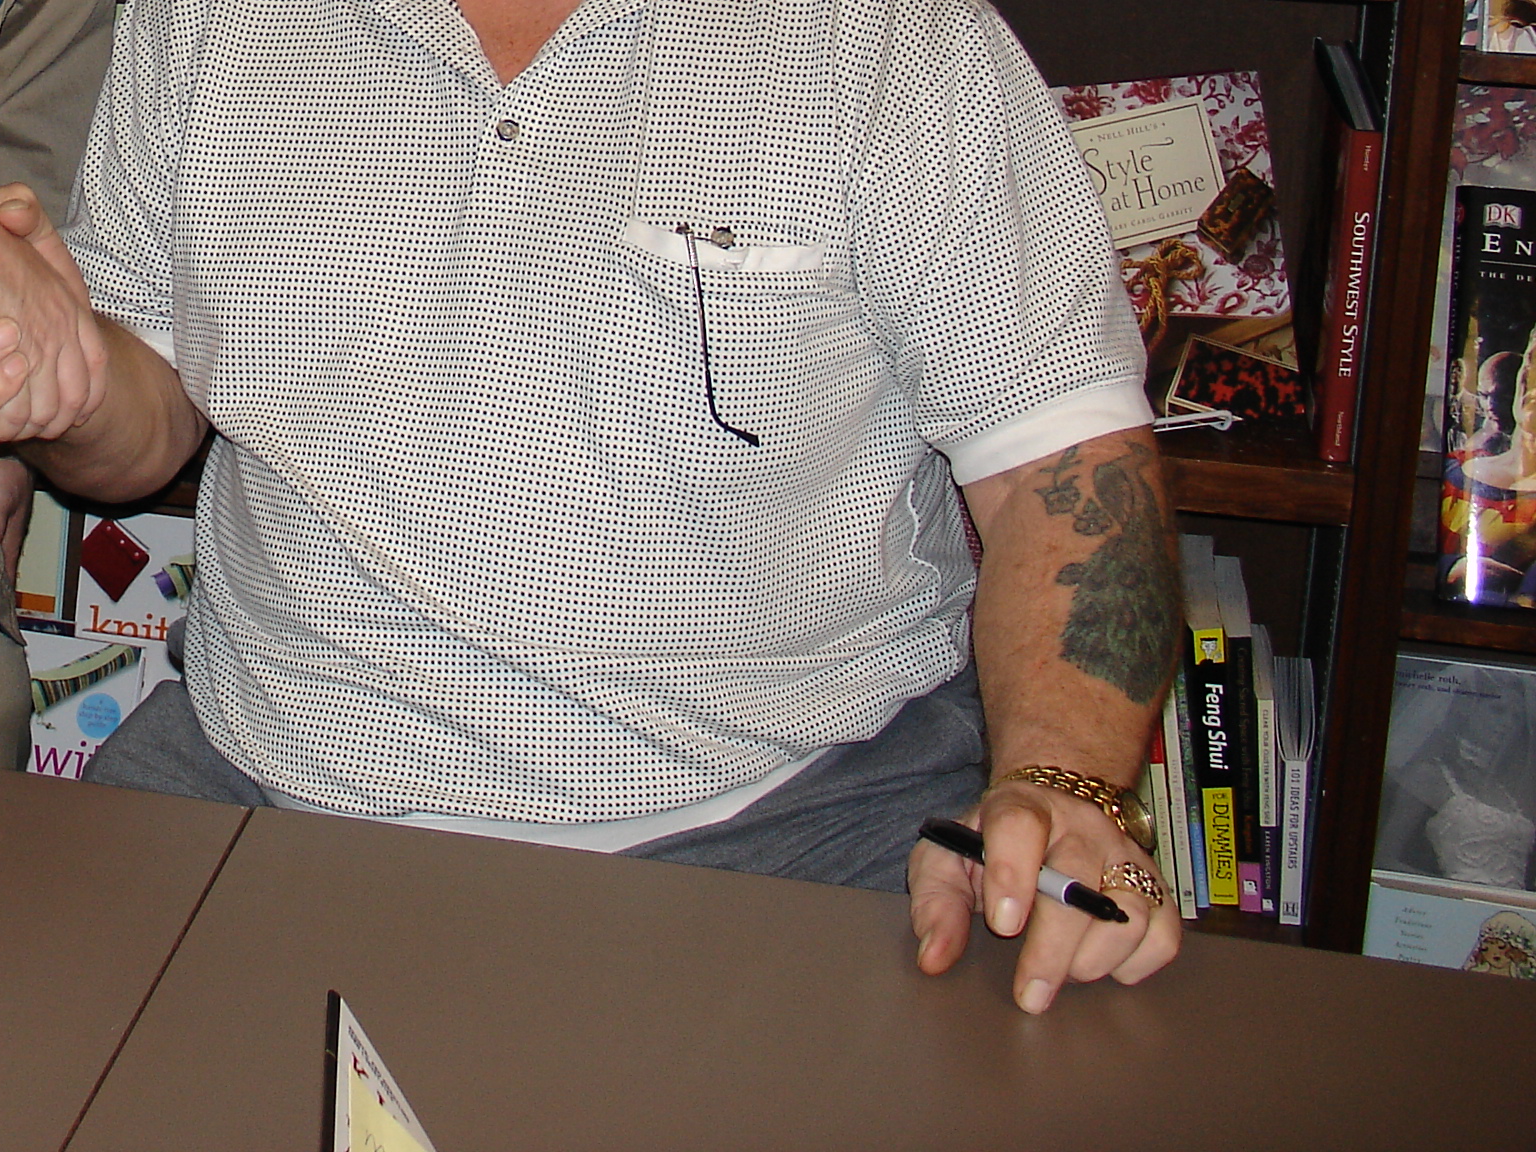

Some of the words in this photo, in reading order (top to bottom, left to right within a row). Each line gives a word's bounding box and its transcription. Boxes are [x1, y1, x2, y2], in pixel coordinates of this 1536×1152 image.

[1097, 131, 1124, 142] NELL
[1127, 123, 1158, 136] HILL'S
[1083, 148, 1154, 196] Style
[1111, 191, 1131, 212] at
[1132, 175, 1205, 210] Home
[1488, 205, 1517, 223] DK
[1344, 211, 1370, 321] SOUTHWEST
[1479, 271, 1506, 280] THE
[1336, 323, 1359, 378] STYLE
[90, 605, 169, 641] knit
[1202, 683, 1224, 727] Feng
[1208, 729, 1230, 771] Shui
[1291, 768, 1301, 784] 101
[1290, 785, 1300, 811] IDEAS
[1212, 802, 1233, 881] DUMMIES
[1289, 814, 1299, 832] FOR
[1288, 832, 1299, 869] UPSTAIRS
